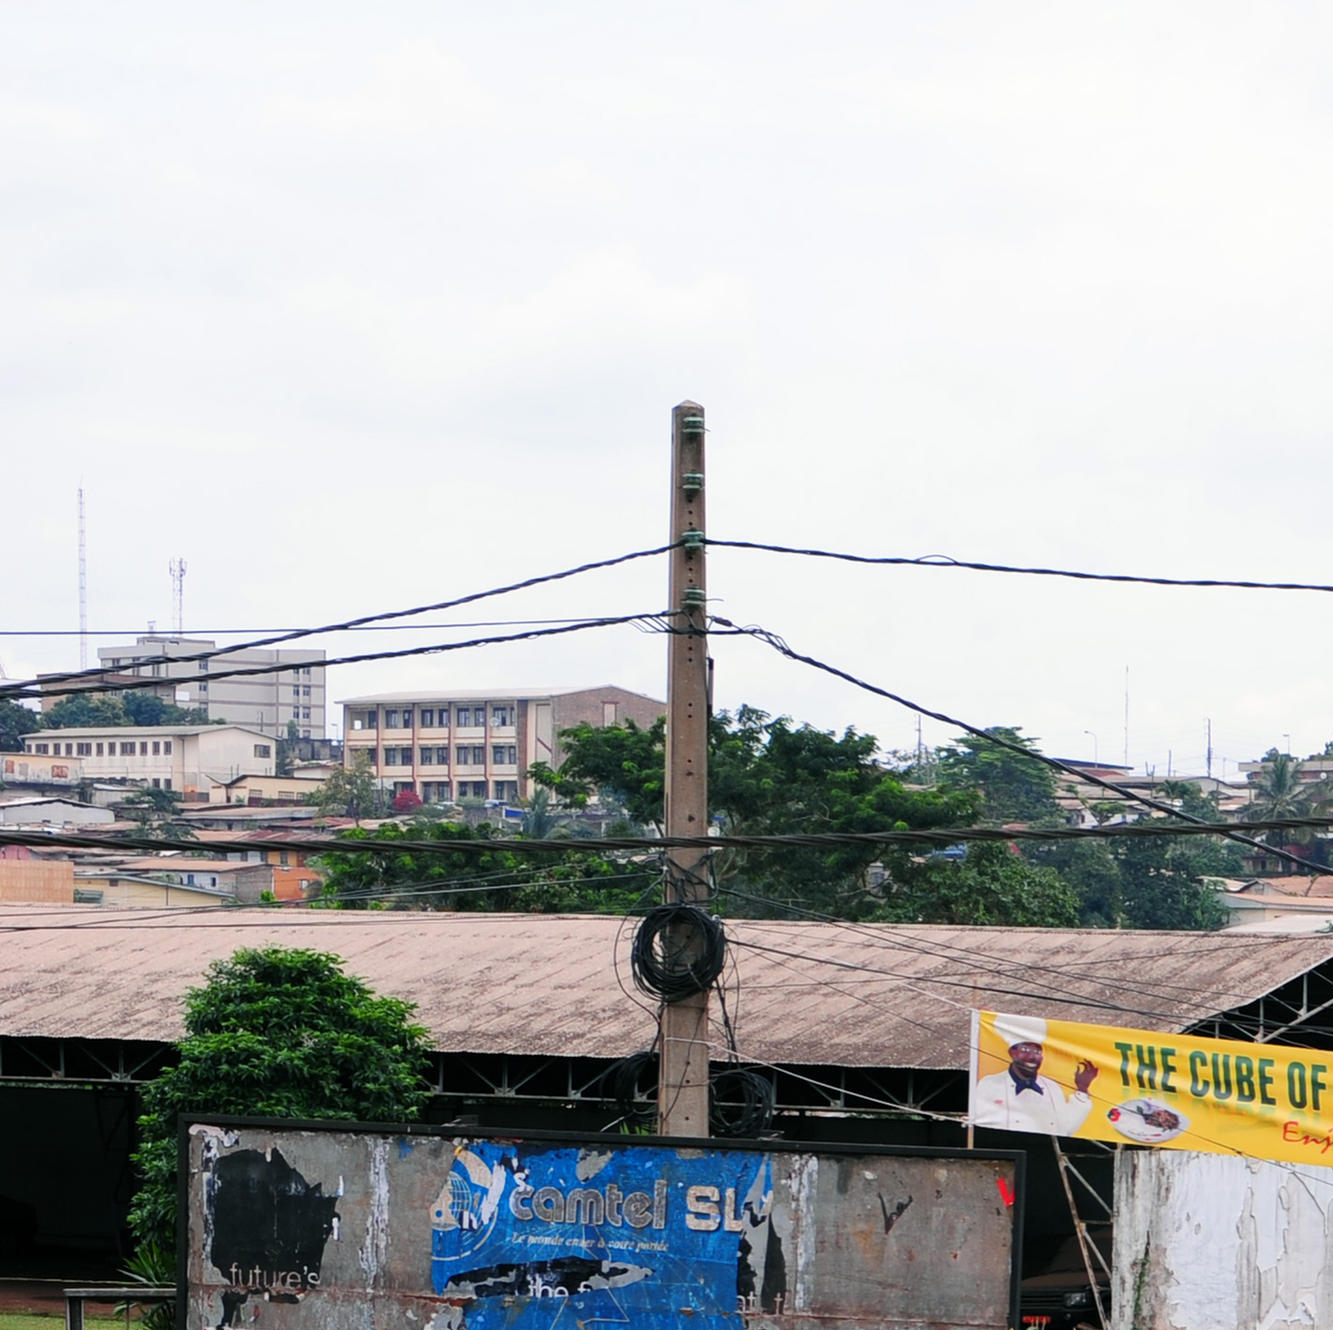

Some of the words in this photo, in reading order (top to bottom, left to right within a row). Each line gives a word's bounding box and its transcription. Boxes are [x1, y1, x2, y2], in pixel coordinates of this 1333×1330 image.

[1115, 1042, 1178, 1094] THE
[1190, 1048, 1276, 1106] CUBE
[1287, 1062, 1326, 1111] OF
[508, 1180, 668, 1229] camtel
